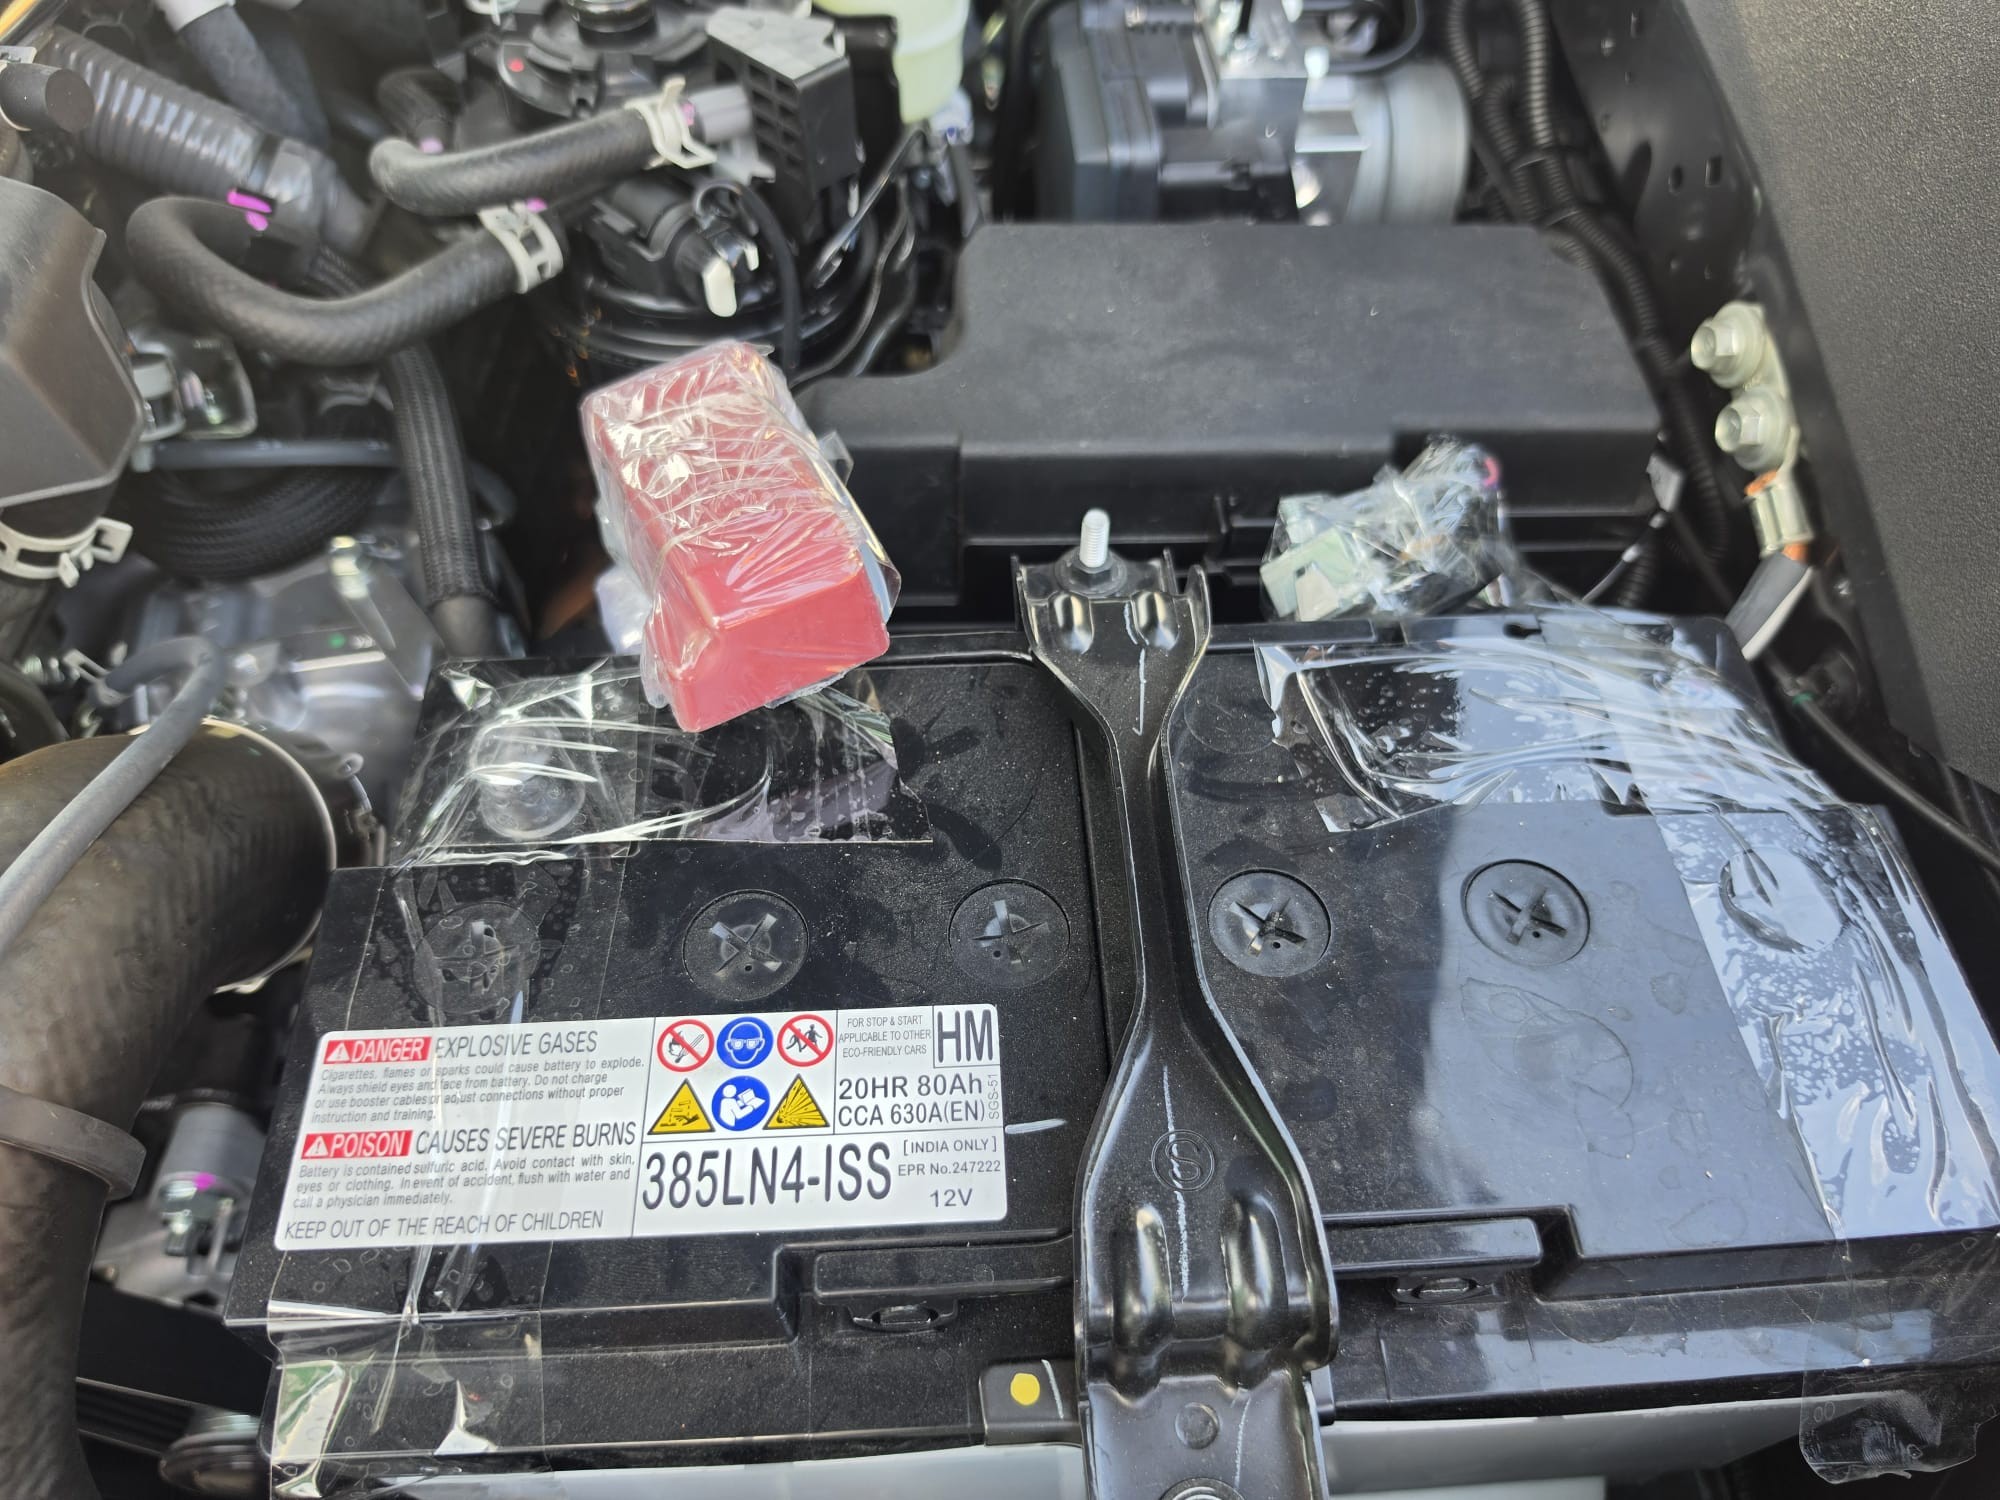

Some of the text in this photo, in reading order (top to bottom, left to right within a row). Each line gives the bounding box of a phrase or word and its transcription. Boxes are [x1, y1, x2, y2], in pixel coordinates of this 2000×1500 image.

[847, 1015, 923, 1028] FOR STOP & START
[352, 1030, 598, 1062] DANGER EXPLOSIVE GASES
[839, 1029, 931, 1043] APPLICABLE TO OTHER
[937, 1009, 993, 1063] HM
[843, 1044, 926, 1057] ECO-FRIENDLY CARS
[321, 1056, 644, 1082] Cigarettes, flames or sparks could cause battery to explode.
[318, 1073, 608, 1095] Always shield eyes and face from battery. Do not charge
[839, 1072, 982, 1100] 20HR 80Ah
[315, 1100, 326, 1109] or
[328, 1098, 346, 1107] use
[350, 1096, 389, 1107] booster
[393, 1094, 427, 1106] cables
[444, 1093, 476, 1106] adjust
[480, 1089, 544, 1102] connections
[548, 1088, 585, 1099] without
[589, 1086, 624, 1099] proper
[988, 1074, 999, 1120] SGS-51
[312, 1109, 436, 1123] instruction and training.
[838, 1099, 985, 1126] CCA 630A(EN)
[330, 1121, 636, 1157] POISON CAUSES SEVERE BURNS
[299, 1165, 340, 1179] Battery
[344, 1165, 353, 1176] is
[356, 1163, 411, 1176] contained
[414, 1161, 454, 1173] sulfuric
[460, 1160, 488, 1172] acid.
[494, 1157, 526, 1170] Avoid
[532, 1155, 575, 1168] contact
[582, 1154, 603, 1166] with
[642, 1141, 892, 1210] 385LN4-ISS
[898, 1160, 1000, 1176] EPR No.247222
[297, 1168, 631, 1194] eyes or clothing. In event of accident, flush with water and
[293, 1191, 452, 1208] call a physician immediately.
[930, 1188, 973, 1207] 12V
[284, 1210, 603, 1239] KEEP OUT OF THE REACH OF CHILDREN
